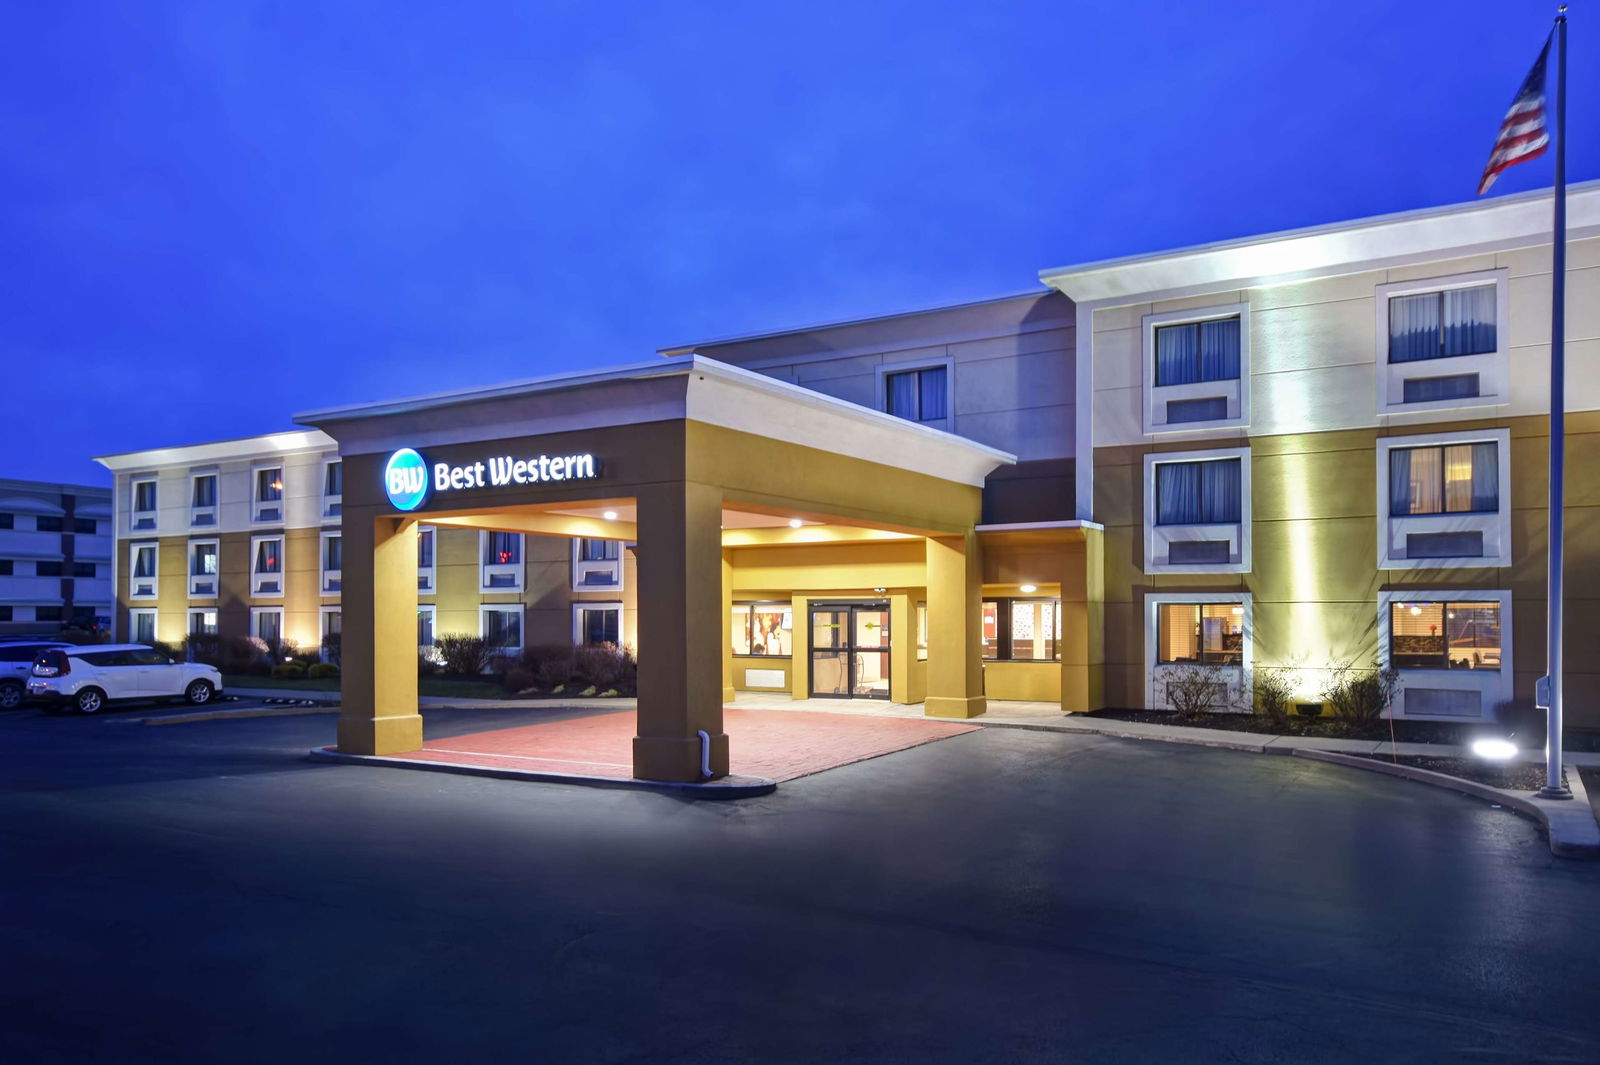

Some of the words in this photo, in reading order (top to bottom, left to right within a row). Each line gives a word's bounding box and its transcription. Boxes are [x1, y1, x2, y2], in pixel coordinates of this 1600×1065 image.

[390, 467, 424, 494] BW
[434, 462, 485, 491] Best
[489, 453, 594, 485] Western
